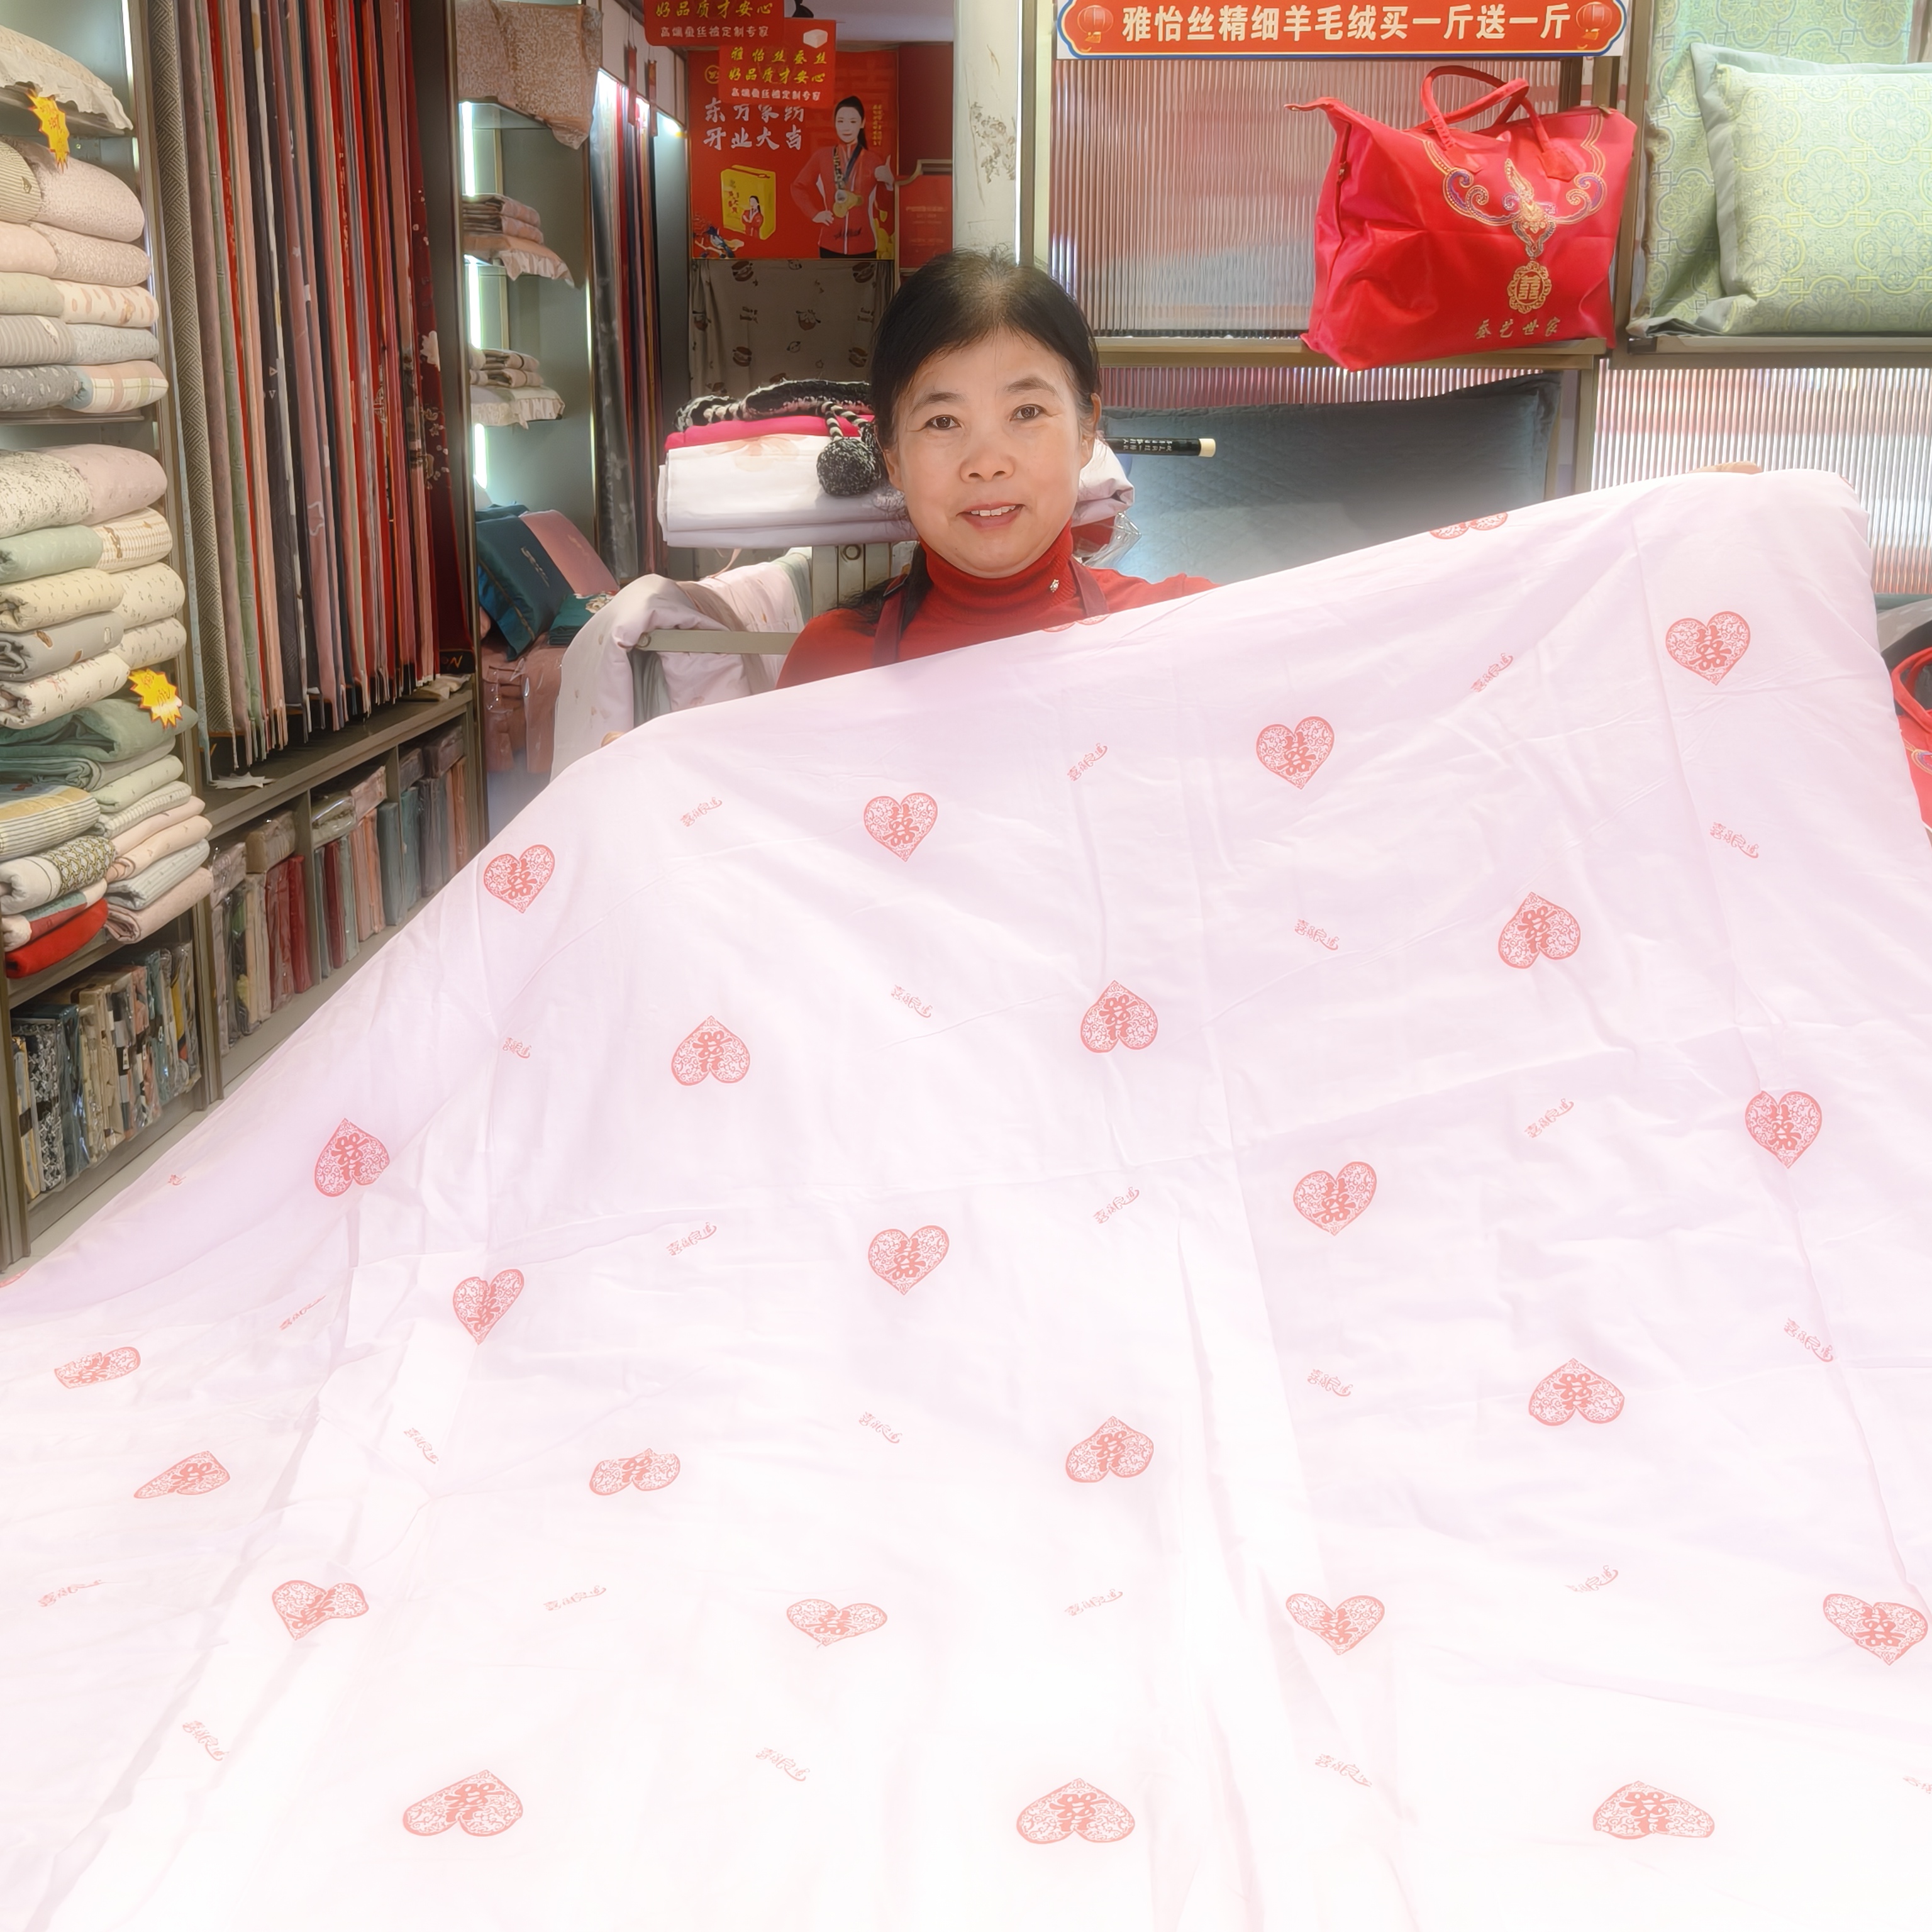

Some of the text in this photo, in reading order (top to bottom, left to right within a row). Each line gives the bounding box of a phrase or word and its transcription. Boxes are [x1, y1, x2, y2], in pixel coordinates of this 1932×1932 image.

[656, 0, 773, 18] 好品质才安心
[1122, 4, 1571, 42] 雅怡丝精细羊毛绒买一斤送一斤
[728, 67, 825, 84] 好品质才安心
[704, 125, 802, 150] 开业大吉
